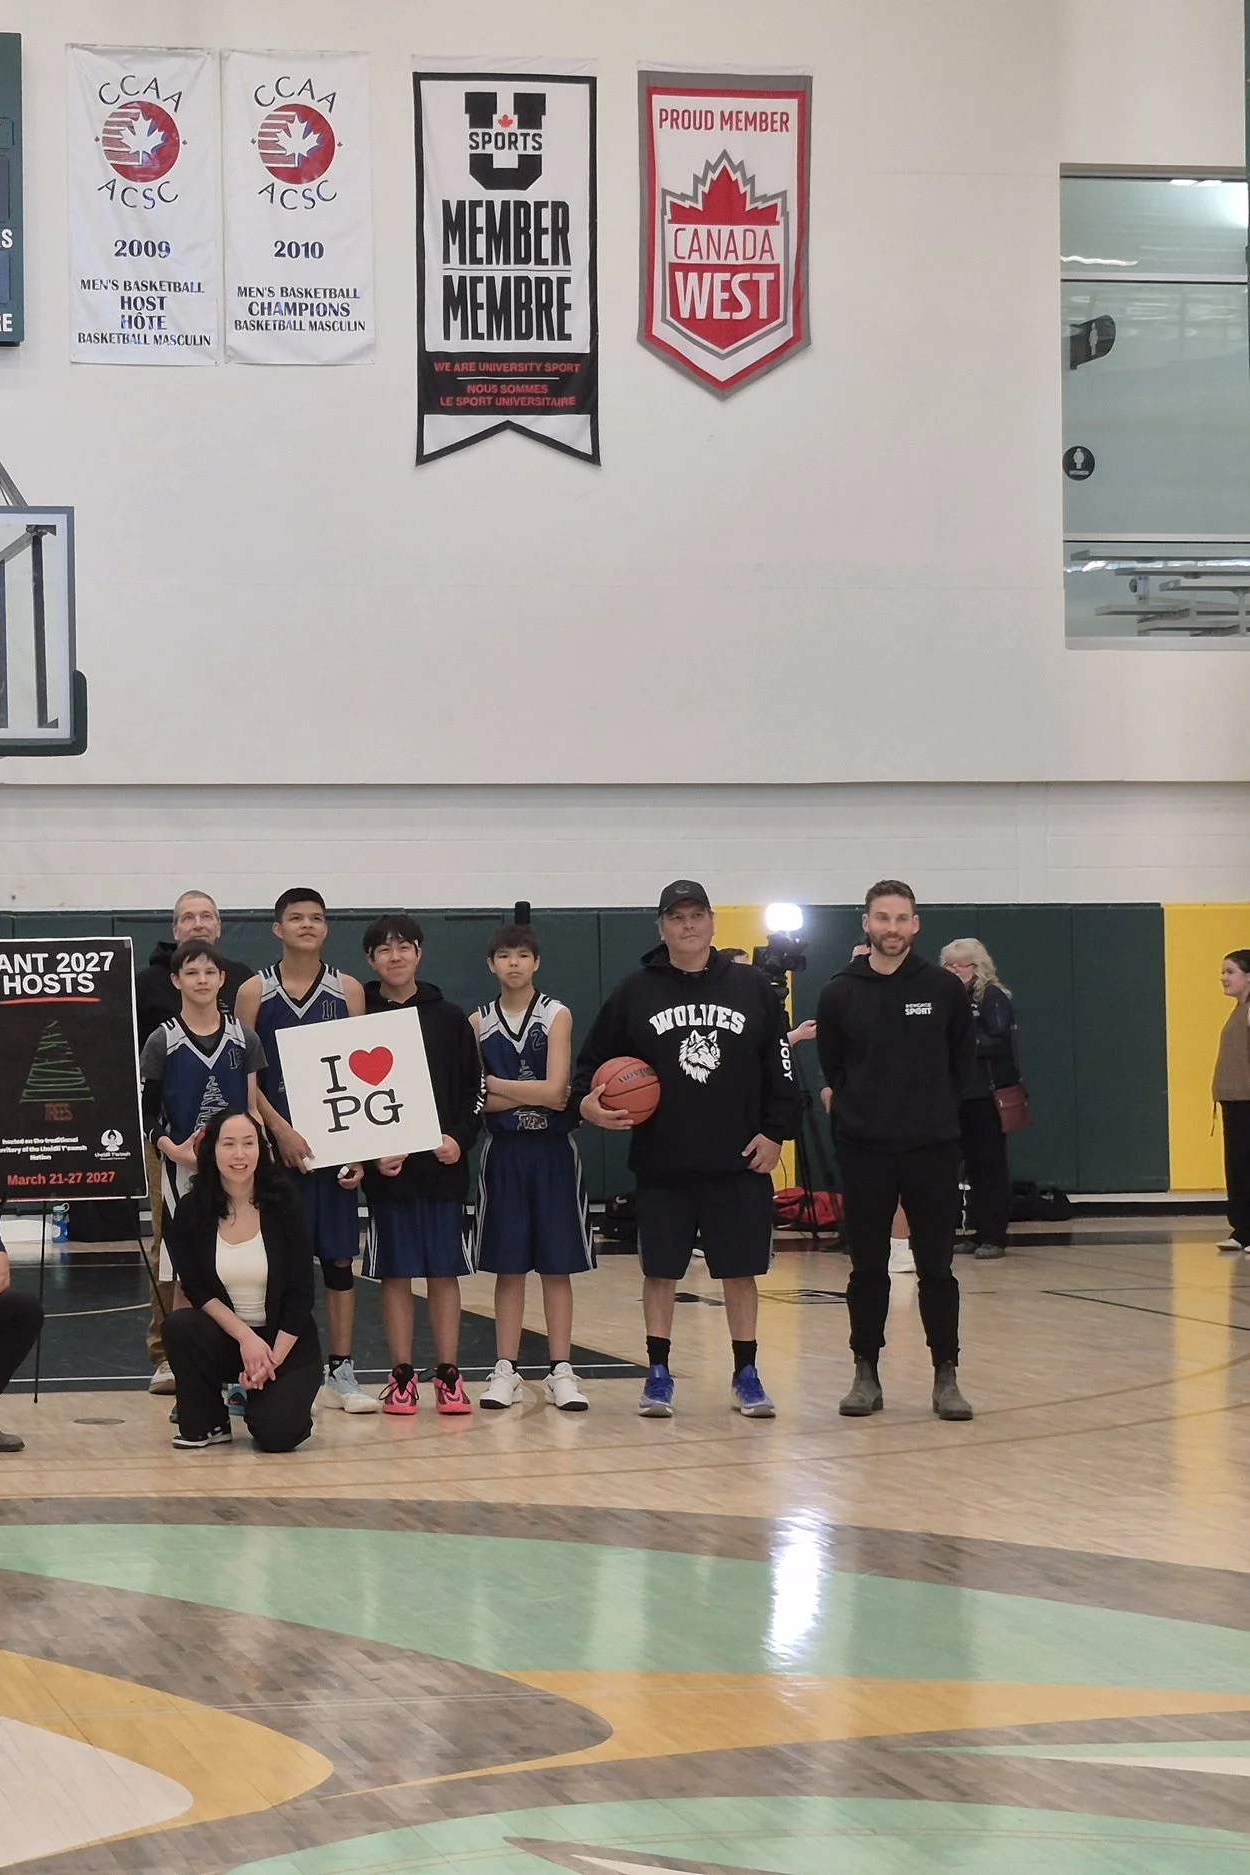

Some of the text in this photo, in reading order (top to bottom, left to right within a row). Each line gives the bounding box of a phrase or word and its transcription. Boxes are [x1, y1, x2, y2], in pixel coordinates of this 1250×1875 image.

[98, 75, 183, 112] CCAA
[253, 76, 337, 113] CCAA
[658, 108, 790, 134] PROUD MEMBER
[469, 132, 542, 151] SPORTS
[97, 178, 179, 210] ACSC
[258, 179, 337, 210] ACSC
[442, 200, 571, 266] MEMBER
[114, 239, 171, 259] 2009
[274, 240, 324, 259] 2010
[673, 227, 775, 261] CANADA
[80, 279, 205, 293] MEN'S BASKETBALL
[237, 286, 360, 299] MEN'S BASKETBALL
[675, 271, 775, 320] WEST
[120, 296, 167, 311] HOST
[248, 301, 351, 317] CHAMPIONS
[442, 275, 572, 341] MEMBRE
[120, 312, 167, 330] HÔTE
[234, 319, 366, 331] BASKETBALL MASCULIN
[78, 332, 211, 346] BASKETBALL MASCULIN
[434, 362, 581, 373] WE ARE UNIVERSITY SPORT
[467, 384, 548, 394] NOUS SOMMES
[440, 396, 576, 407] LE SPORT UNIVERSITAIRE
[56, 952, 114, 973] 2027
[3, 973, 95, 996] HOSTS
[649, 1004, 746, 1035] WOLVES
[779, 1038, 794, 1082] JODY
[320, 1055, 347, 1093] I
[324, 1090, 404, 1133] PG
[7, 1171, 116, 1186] March 21-27 2027
